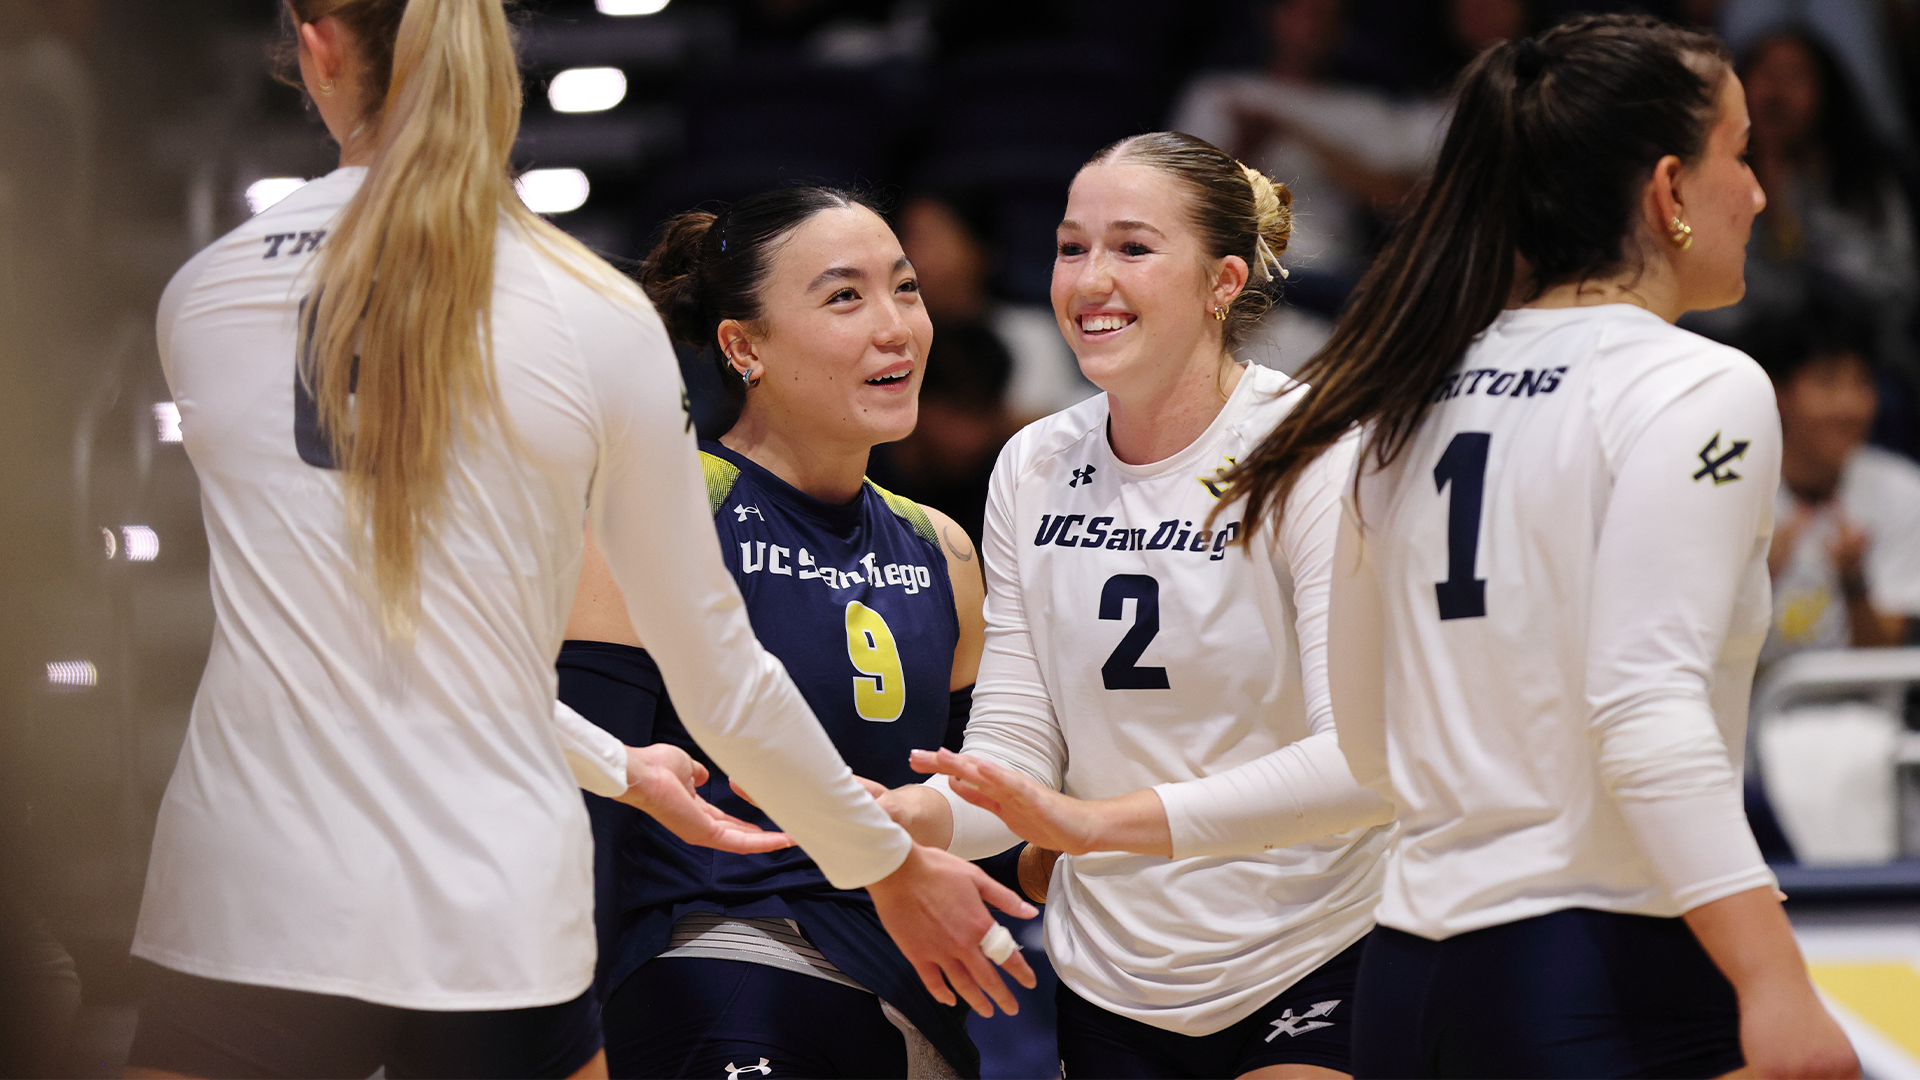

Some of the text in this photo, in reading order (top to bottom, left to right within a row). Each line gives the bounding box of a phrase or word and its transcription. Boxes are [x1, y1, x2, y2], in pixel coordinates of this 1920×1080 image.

[1436, 366, 1569, 402] RITONS
[1434, 432, 1491, 620] 1
[845, 600, 905, 722] 9
[1098, 574, 1170, 689] 2
